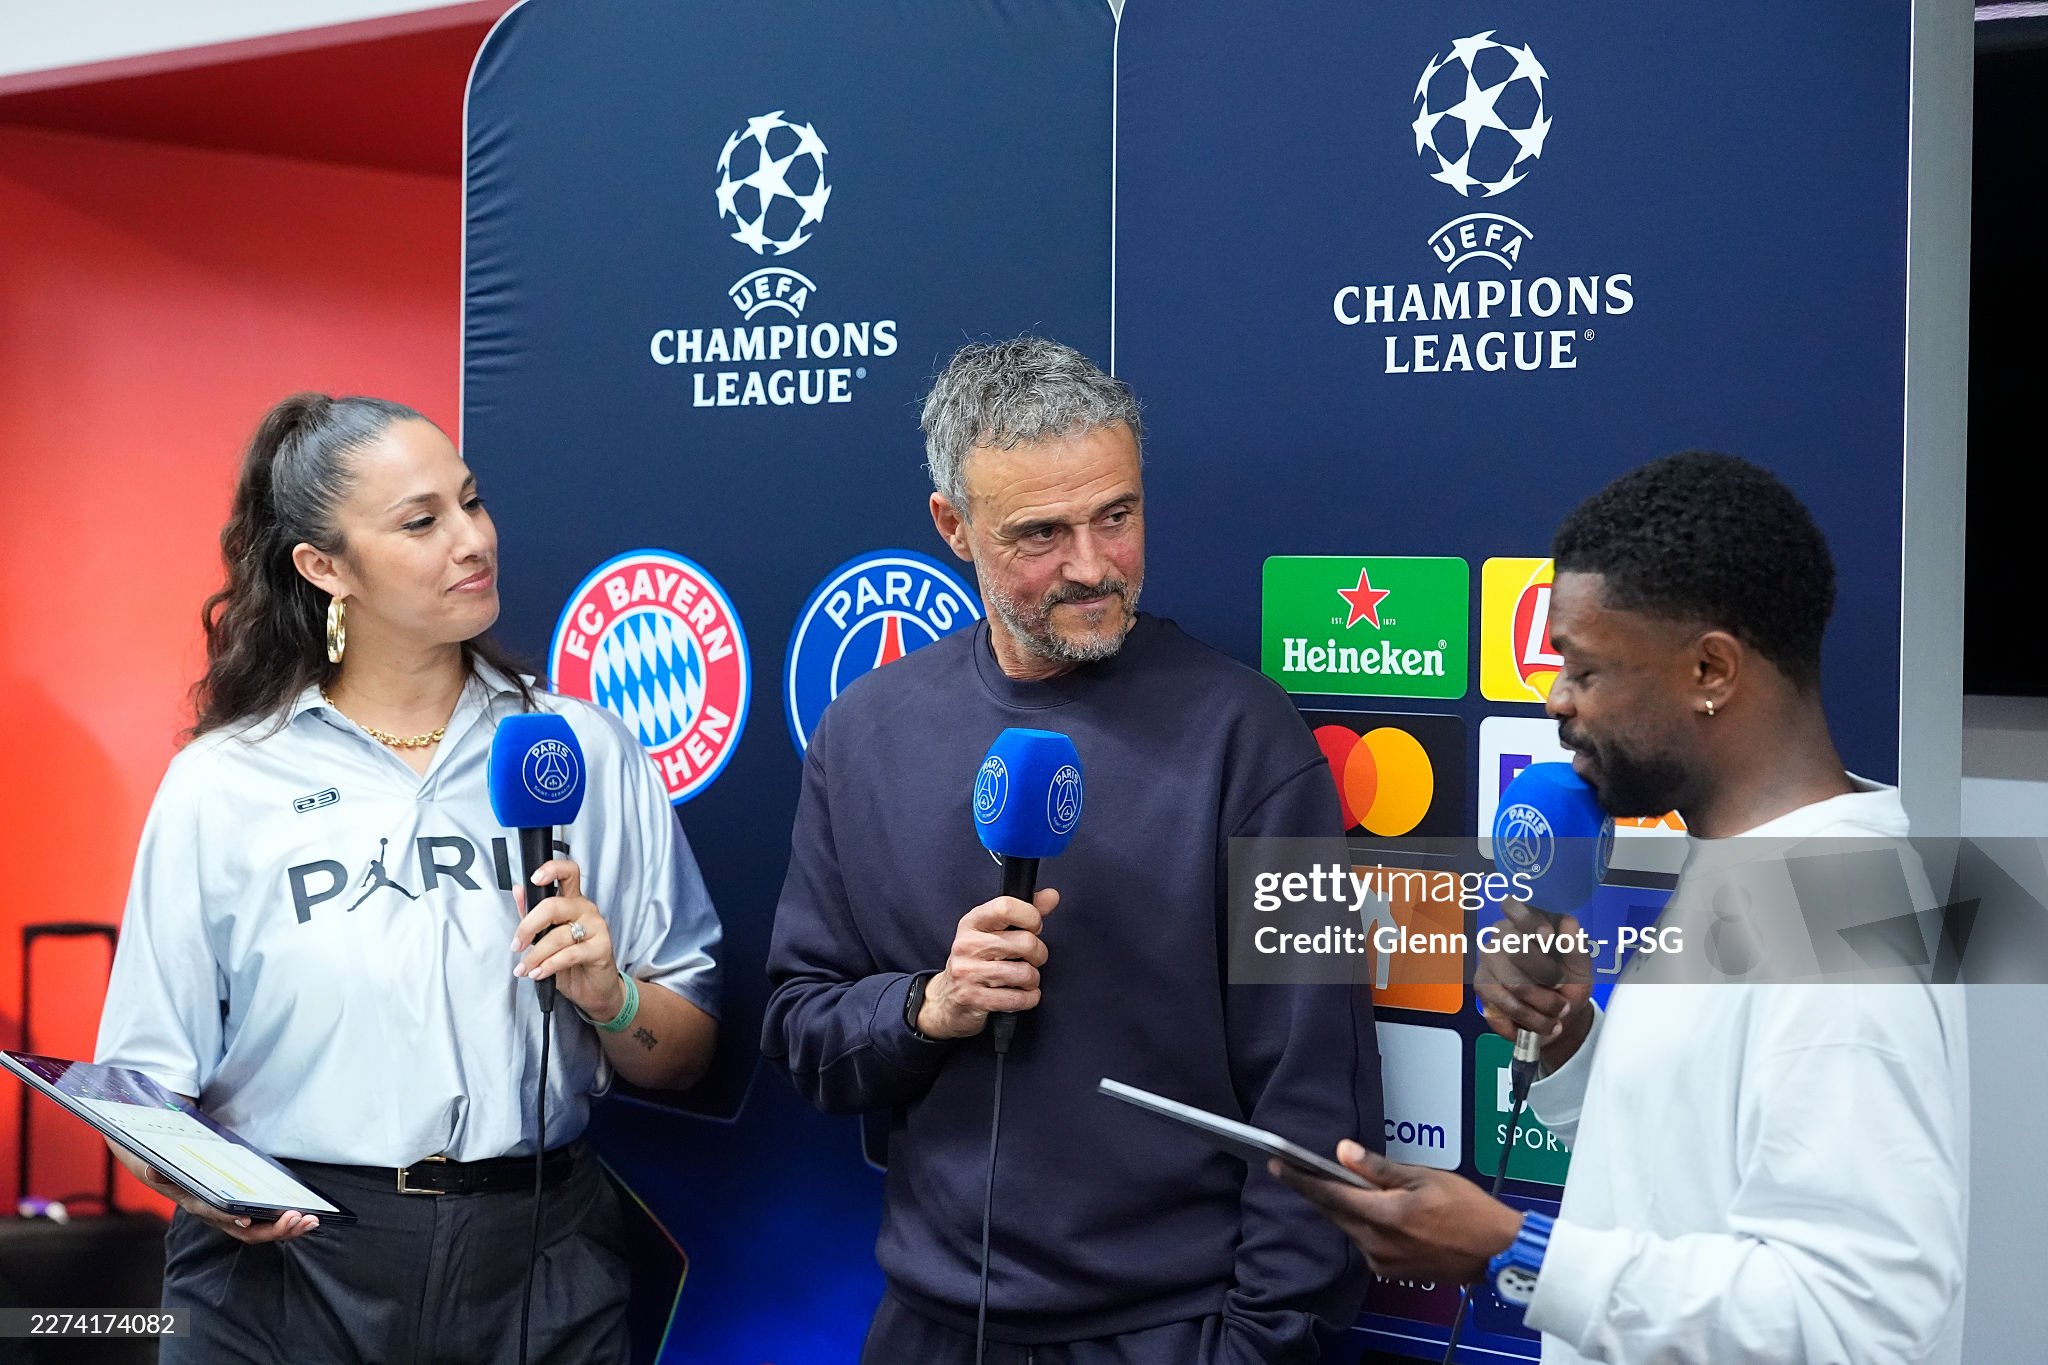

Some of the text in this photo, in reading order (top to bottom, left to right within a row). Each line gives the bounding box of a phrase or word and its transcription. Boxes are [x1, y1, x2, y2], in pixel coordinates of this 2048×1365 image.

[1433, 223, 1522, 263] UEFA
[732, 276, 806, 312] UEFA
[1333, 273, 1634, 326] CHAMPIONS
[650, 320, 898, 365] CHAMPIONS
[692, 368, 853, 408] LEAGUE
[565, 567, 734, 664] FC BAYERN
[823, 571, 961, 631] PARIS
[531, 742, 569, 759] PARIS
[982, 759, 1005, 778] PARIS
[1055, 768, 1079, 786] PARIS
[1508, 808, 1548, 835] PARIS
[1496, 1123, 1569, 1153] SPOR
